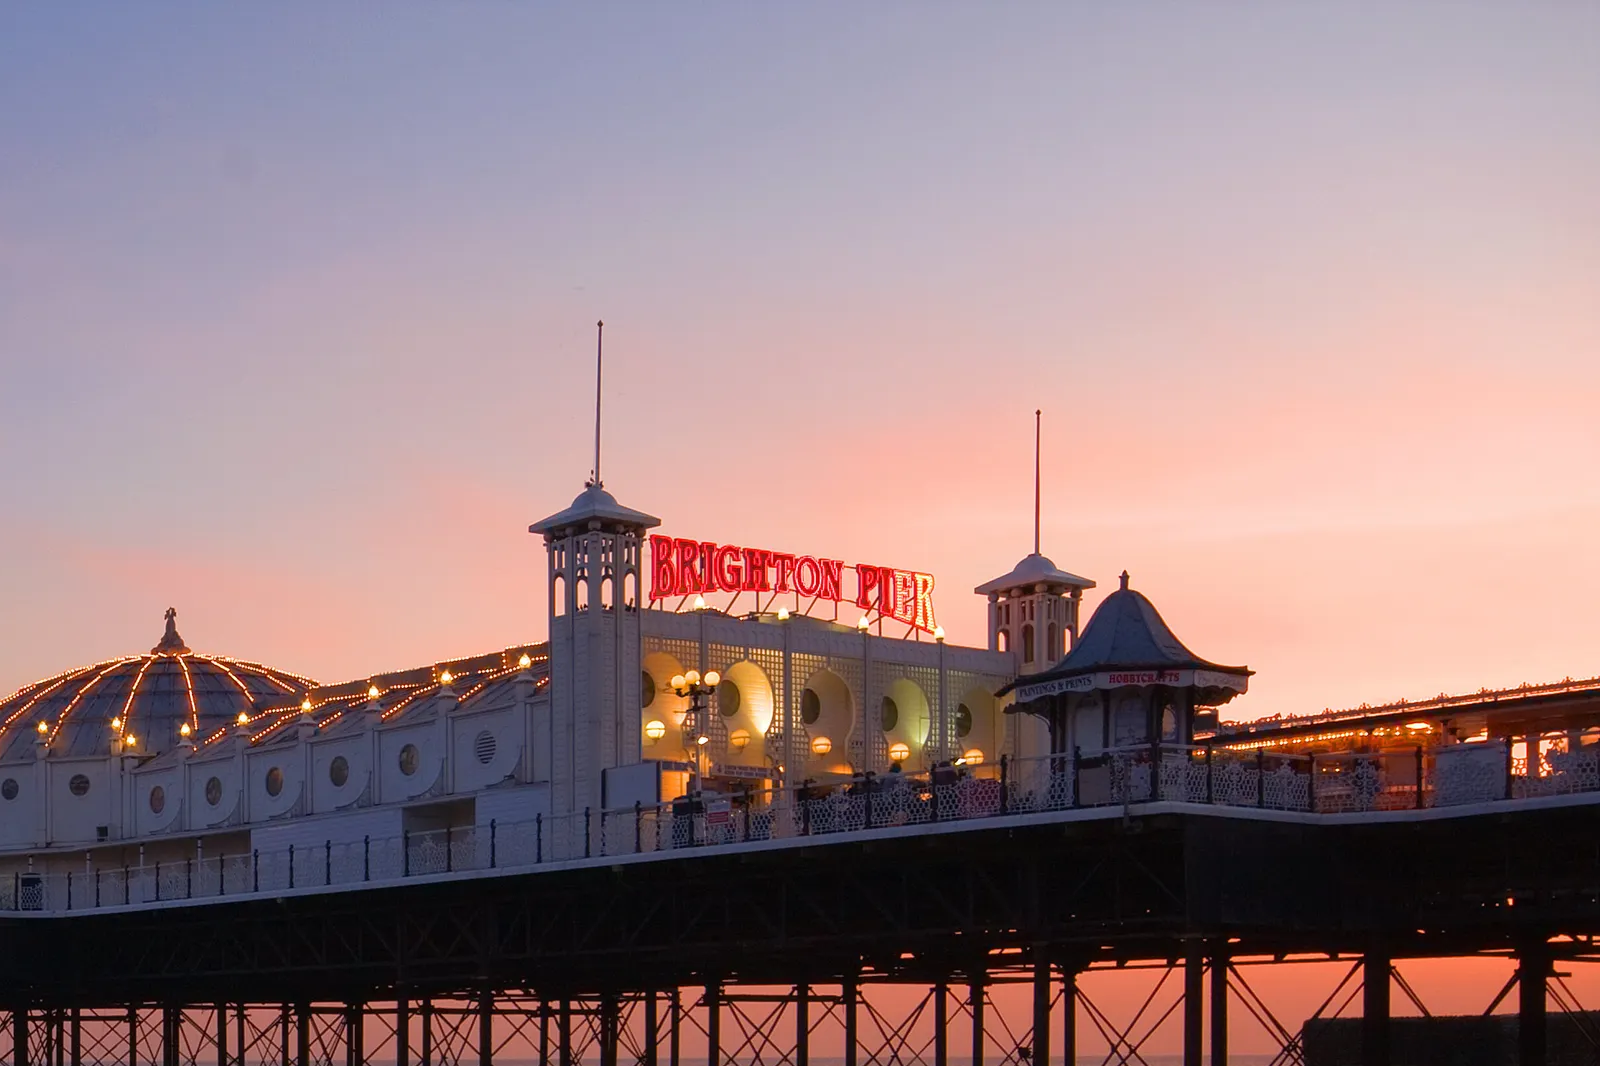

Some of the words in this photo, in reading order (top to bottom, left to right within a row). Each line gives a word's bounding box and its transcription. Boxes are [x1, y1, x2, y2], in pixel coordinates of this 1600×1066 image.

[649, 534, 844, 601] BRIGHTON
[856, 563, 938, 635] PIER
[1019, 682, 1056, 698] PAINTINGS
[1065, 677, 1093, 690] PRINTS
[1108, 672, 1180, 685] HOBBYCRAFTS
